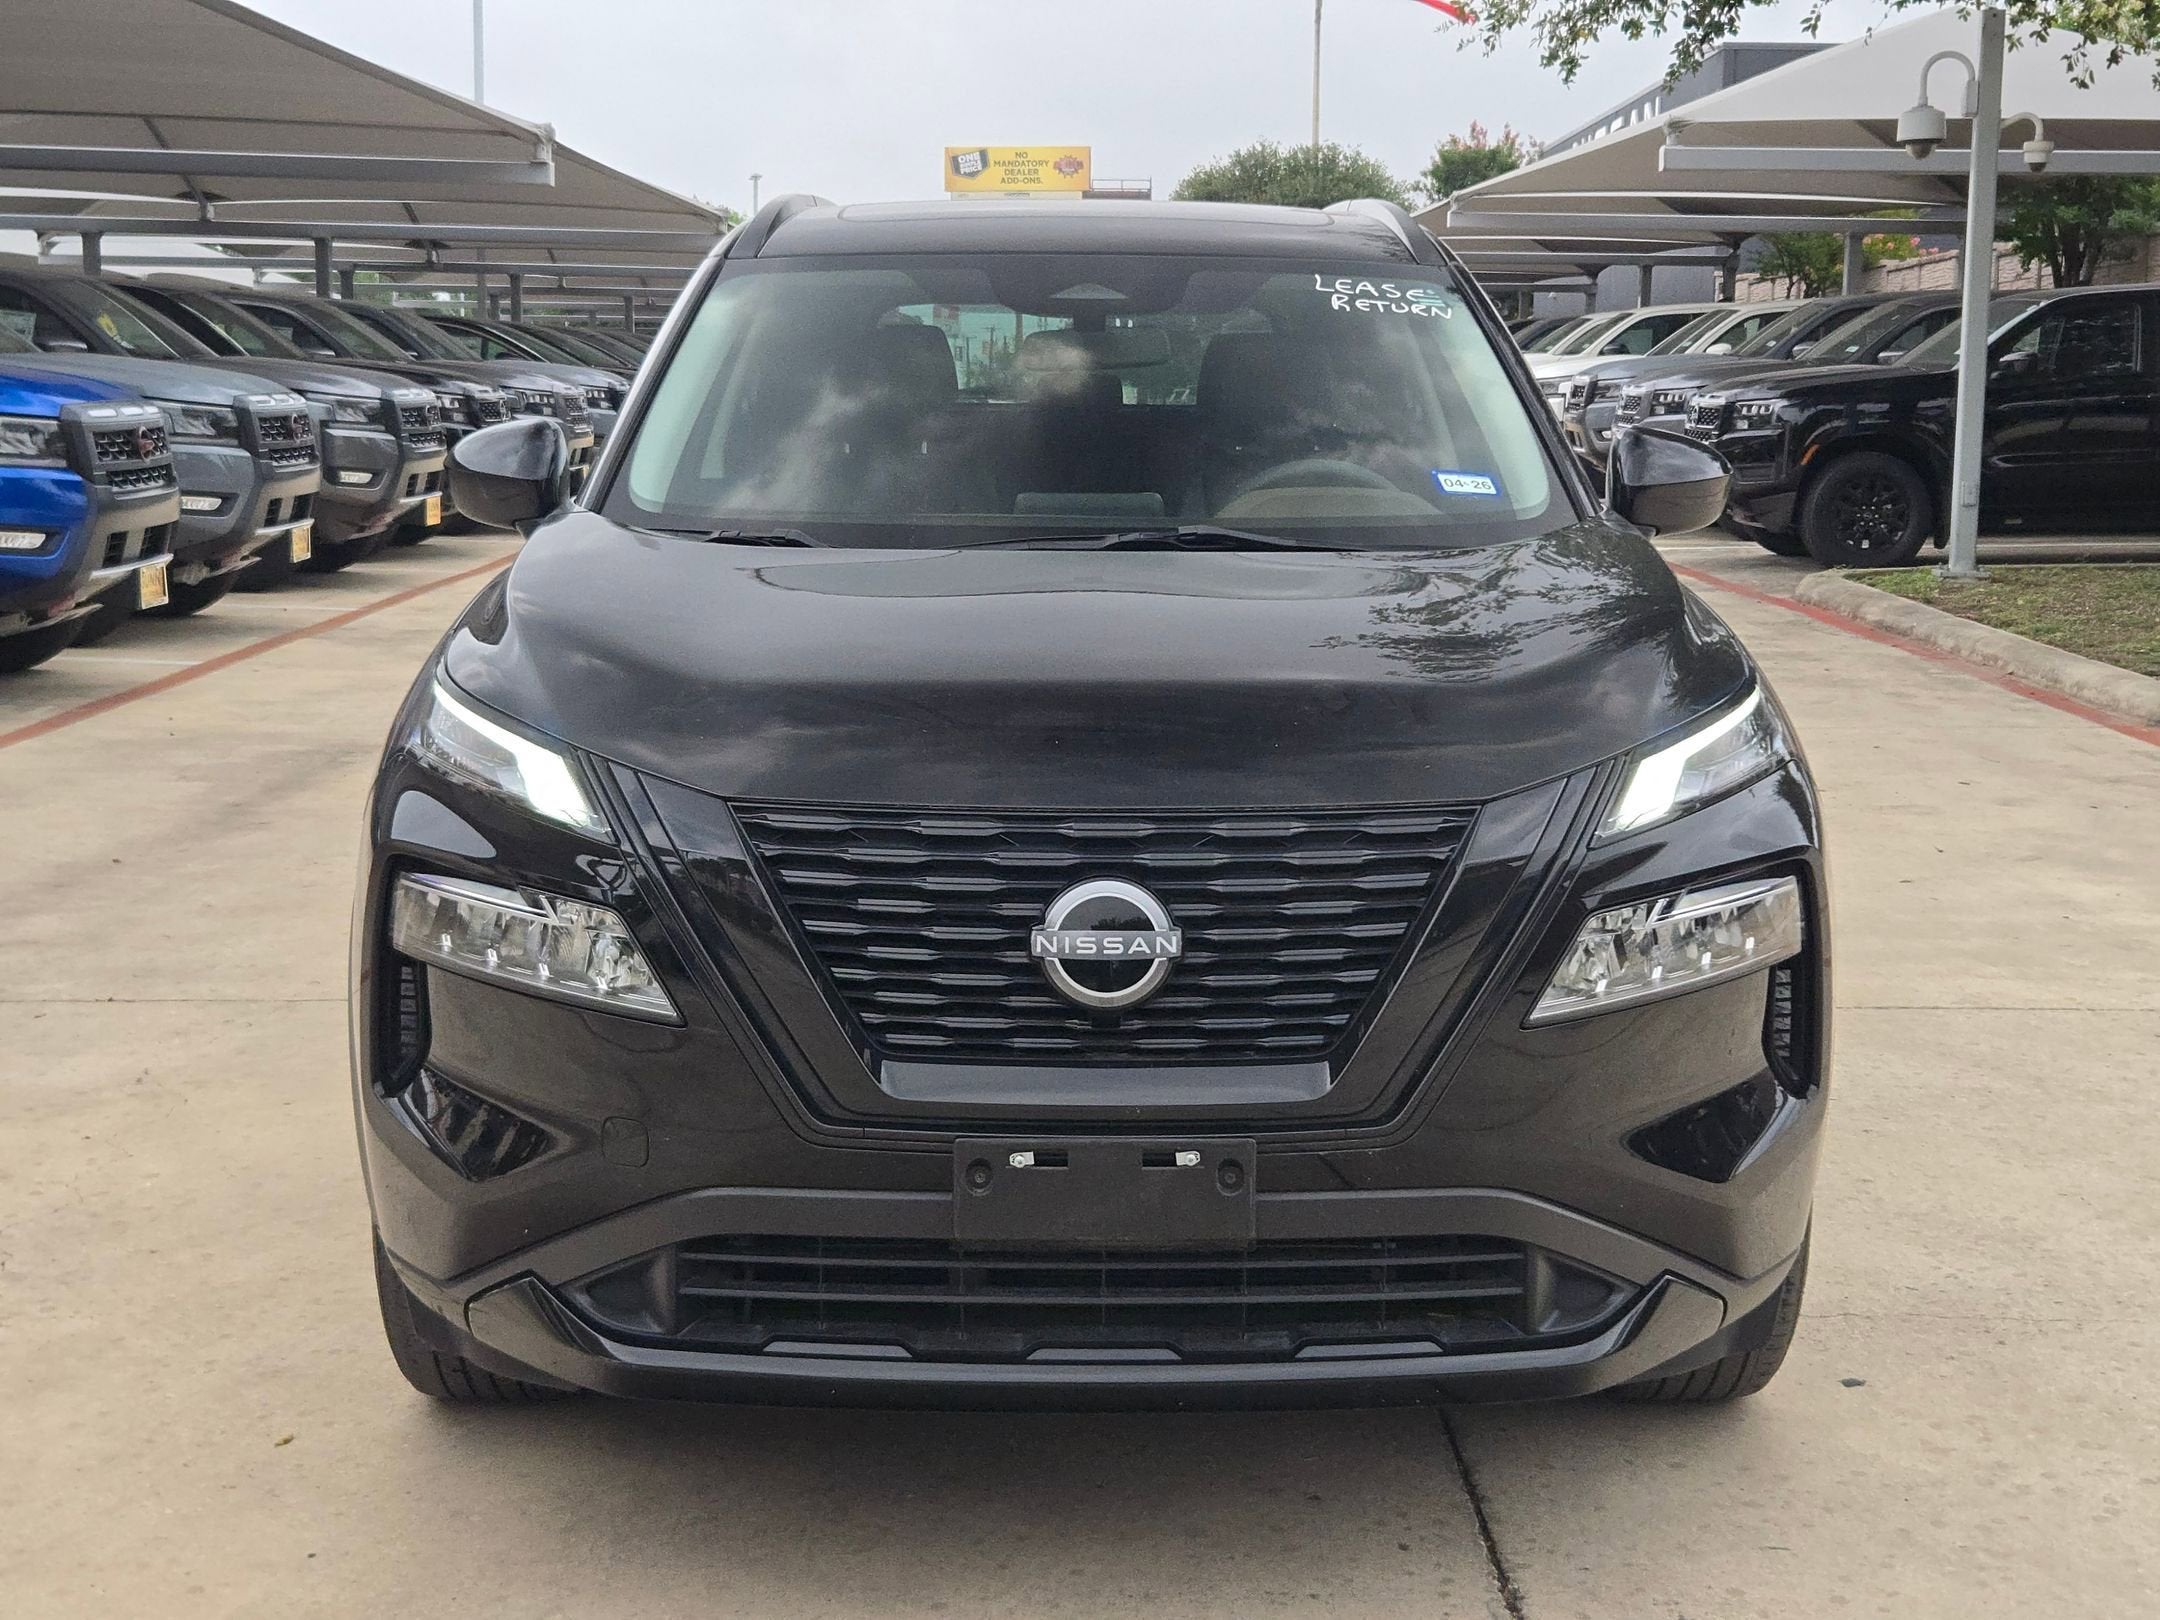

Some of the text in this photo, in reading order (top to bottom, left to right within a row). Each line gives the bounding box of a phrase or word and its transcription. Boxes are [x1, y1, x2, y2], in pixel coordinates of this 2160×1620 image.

[958, 151, 980, 163] ONE
[1015, 151, 1028, 159] NO
[993, 160, 1050, 168] MANDATORY
[1004, 168, 1039, 176] DEALER
[1314, 274, 1427, 302] LEASE
[1331, 293, 1452, 320] RETURN
[1036, 935, 1177, 955] NISSAN
